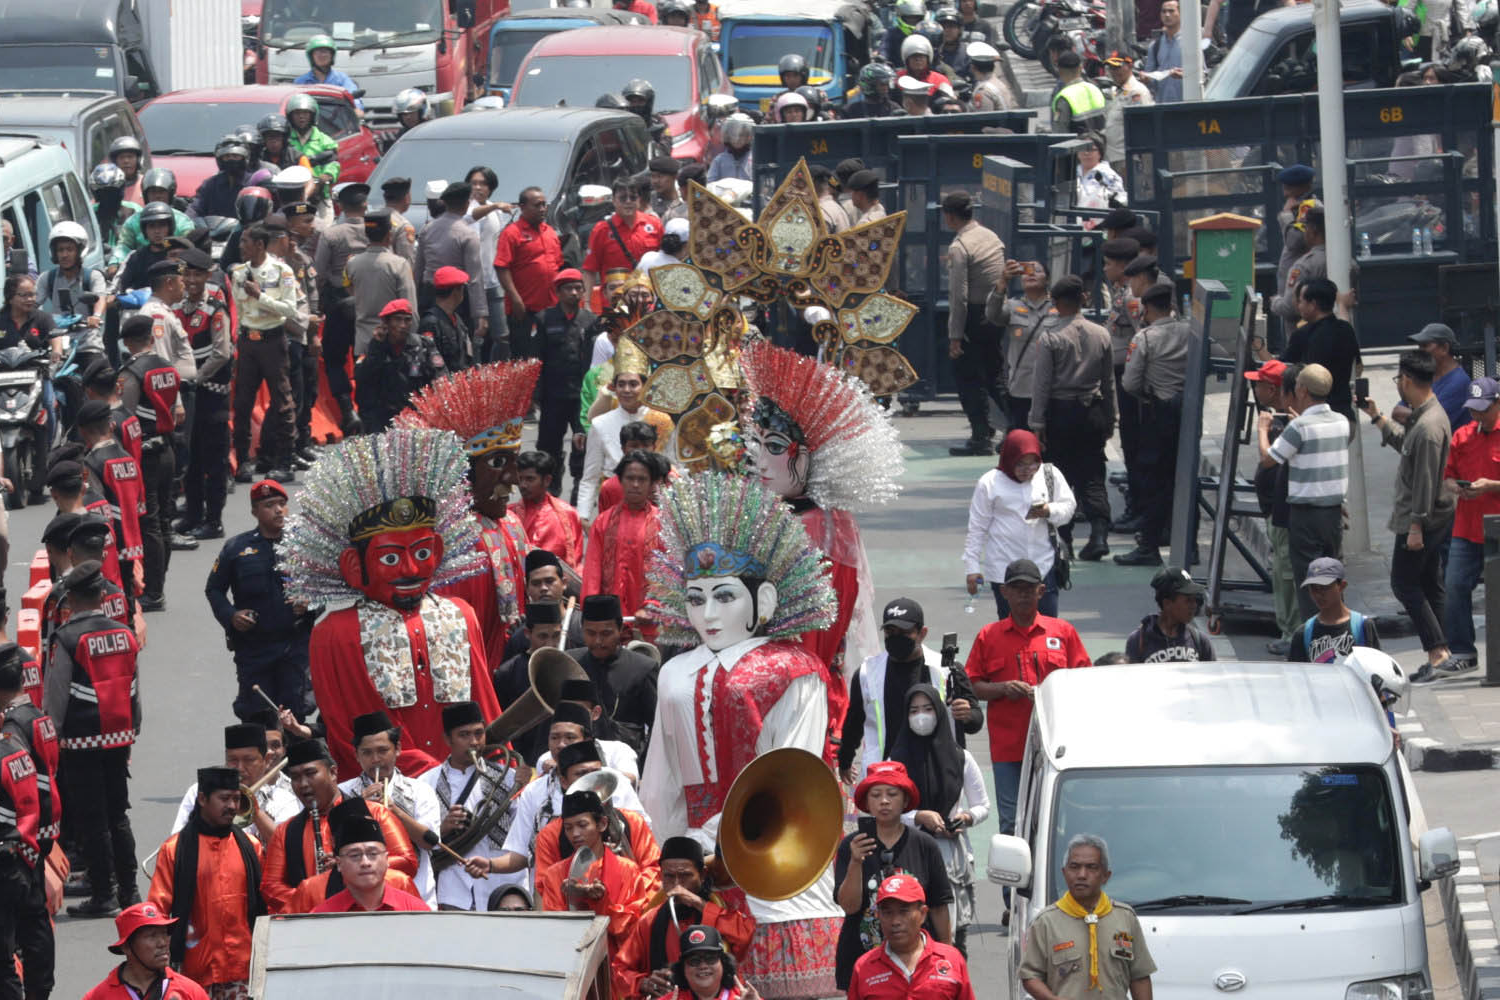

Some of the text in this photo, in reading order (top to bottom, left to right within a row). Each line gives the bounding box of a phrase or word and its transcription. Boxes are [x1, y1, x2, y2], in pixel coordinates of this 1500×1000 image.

[1380, 107, 1404, 123] 6B
[1197, 119, 1221, 135] 1A
[87, 632, 130, 657] POLISI
